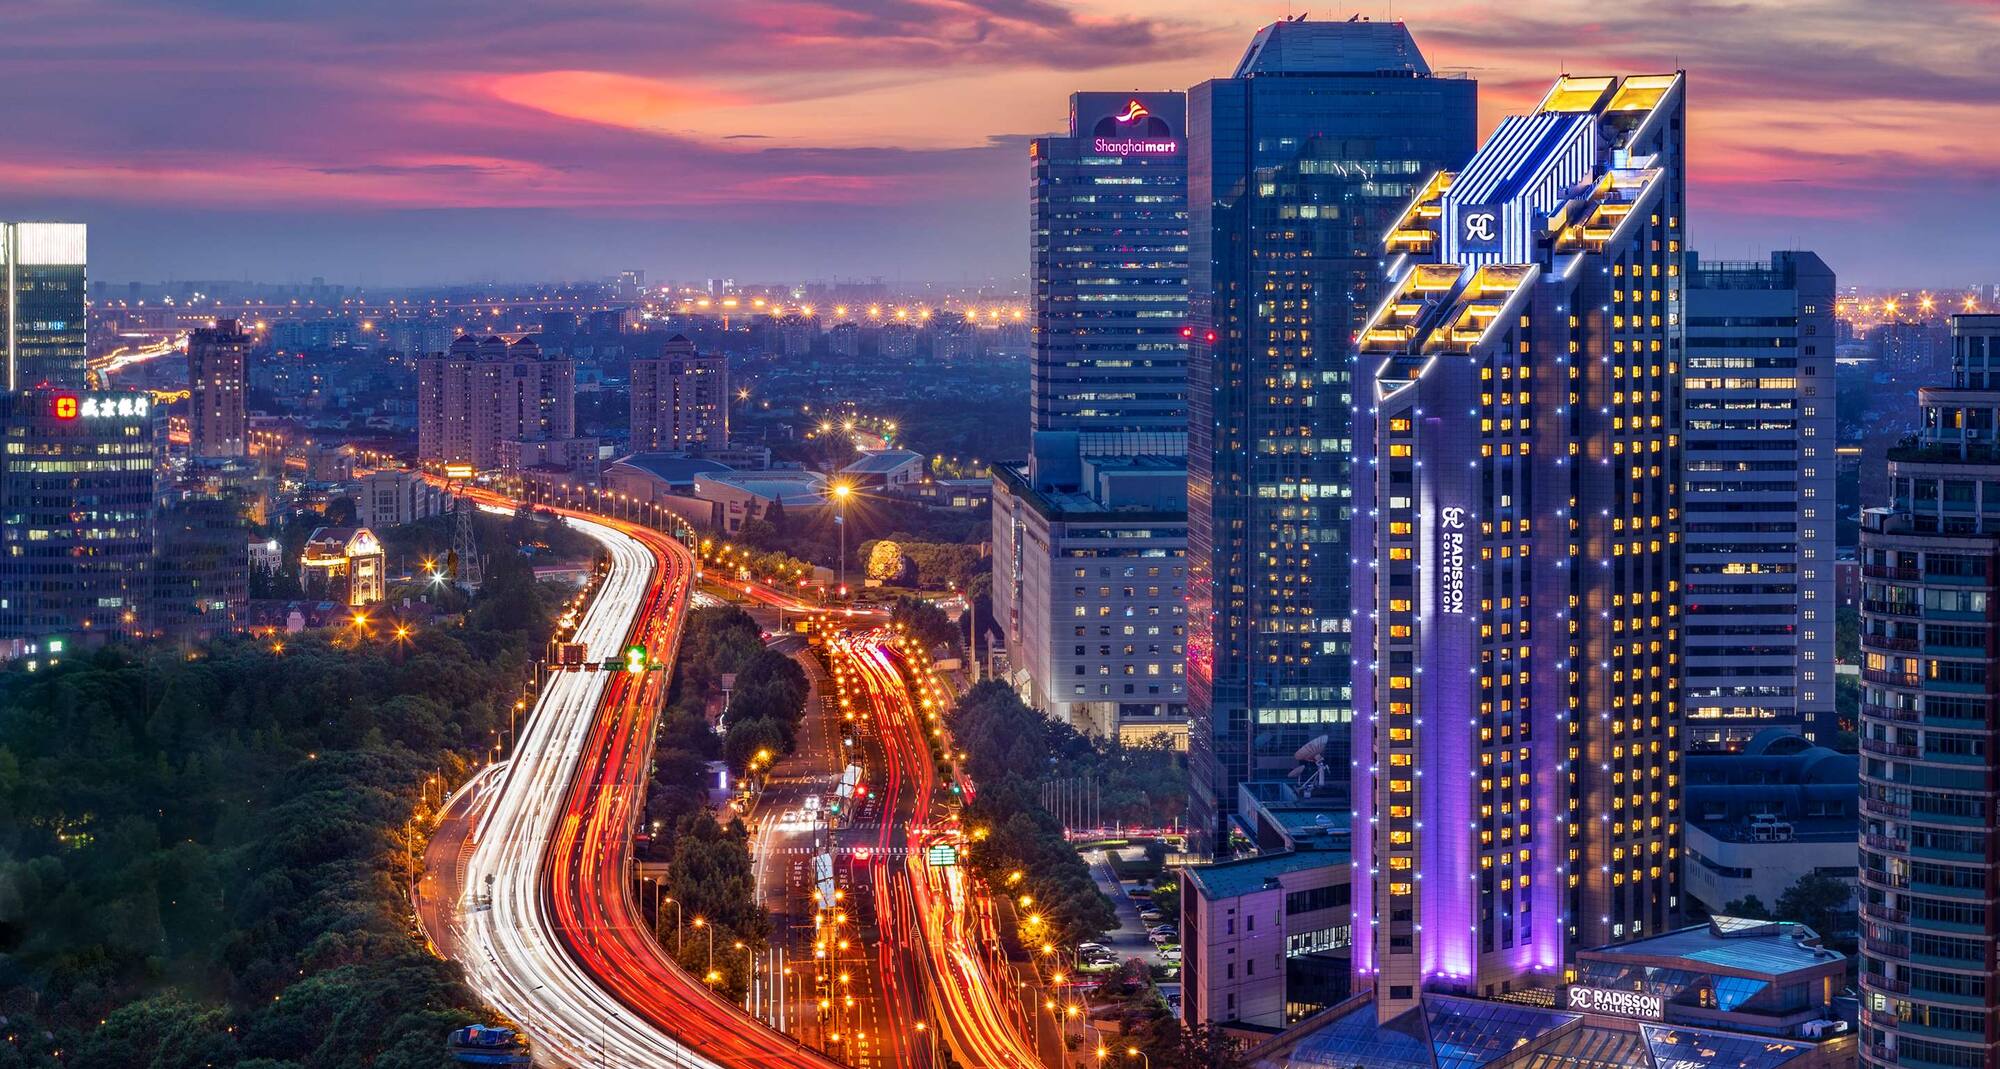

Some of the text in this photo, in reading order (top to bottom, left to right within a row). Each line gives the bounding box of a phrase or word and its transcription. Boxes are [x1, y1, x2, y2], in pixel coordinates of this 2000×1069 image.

[1095, 138, 1176, 156] Shanghaimart
[1443, 532, 1451, 613] COLLECTION
[1451, 533, 1463, 614] RADISSON
[1593, 989, 1660, 1011] RADISSON
[1593, 1002, 1660, 1018] COLLECTION
